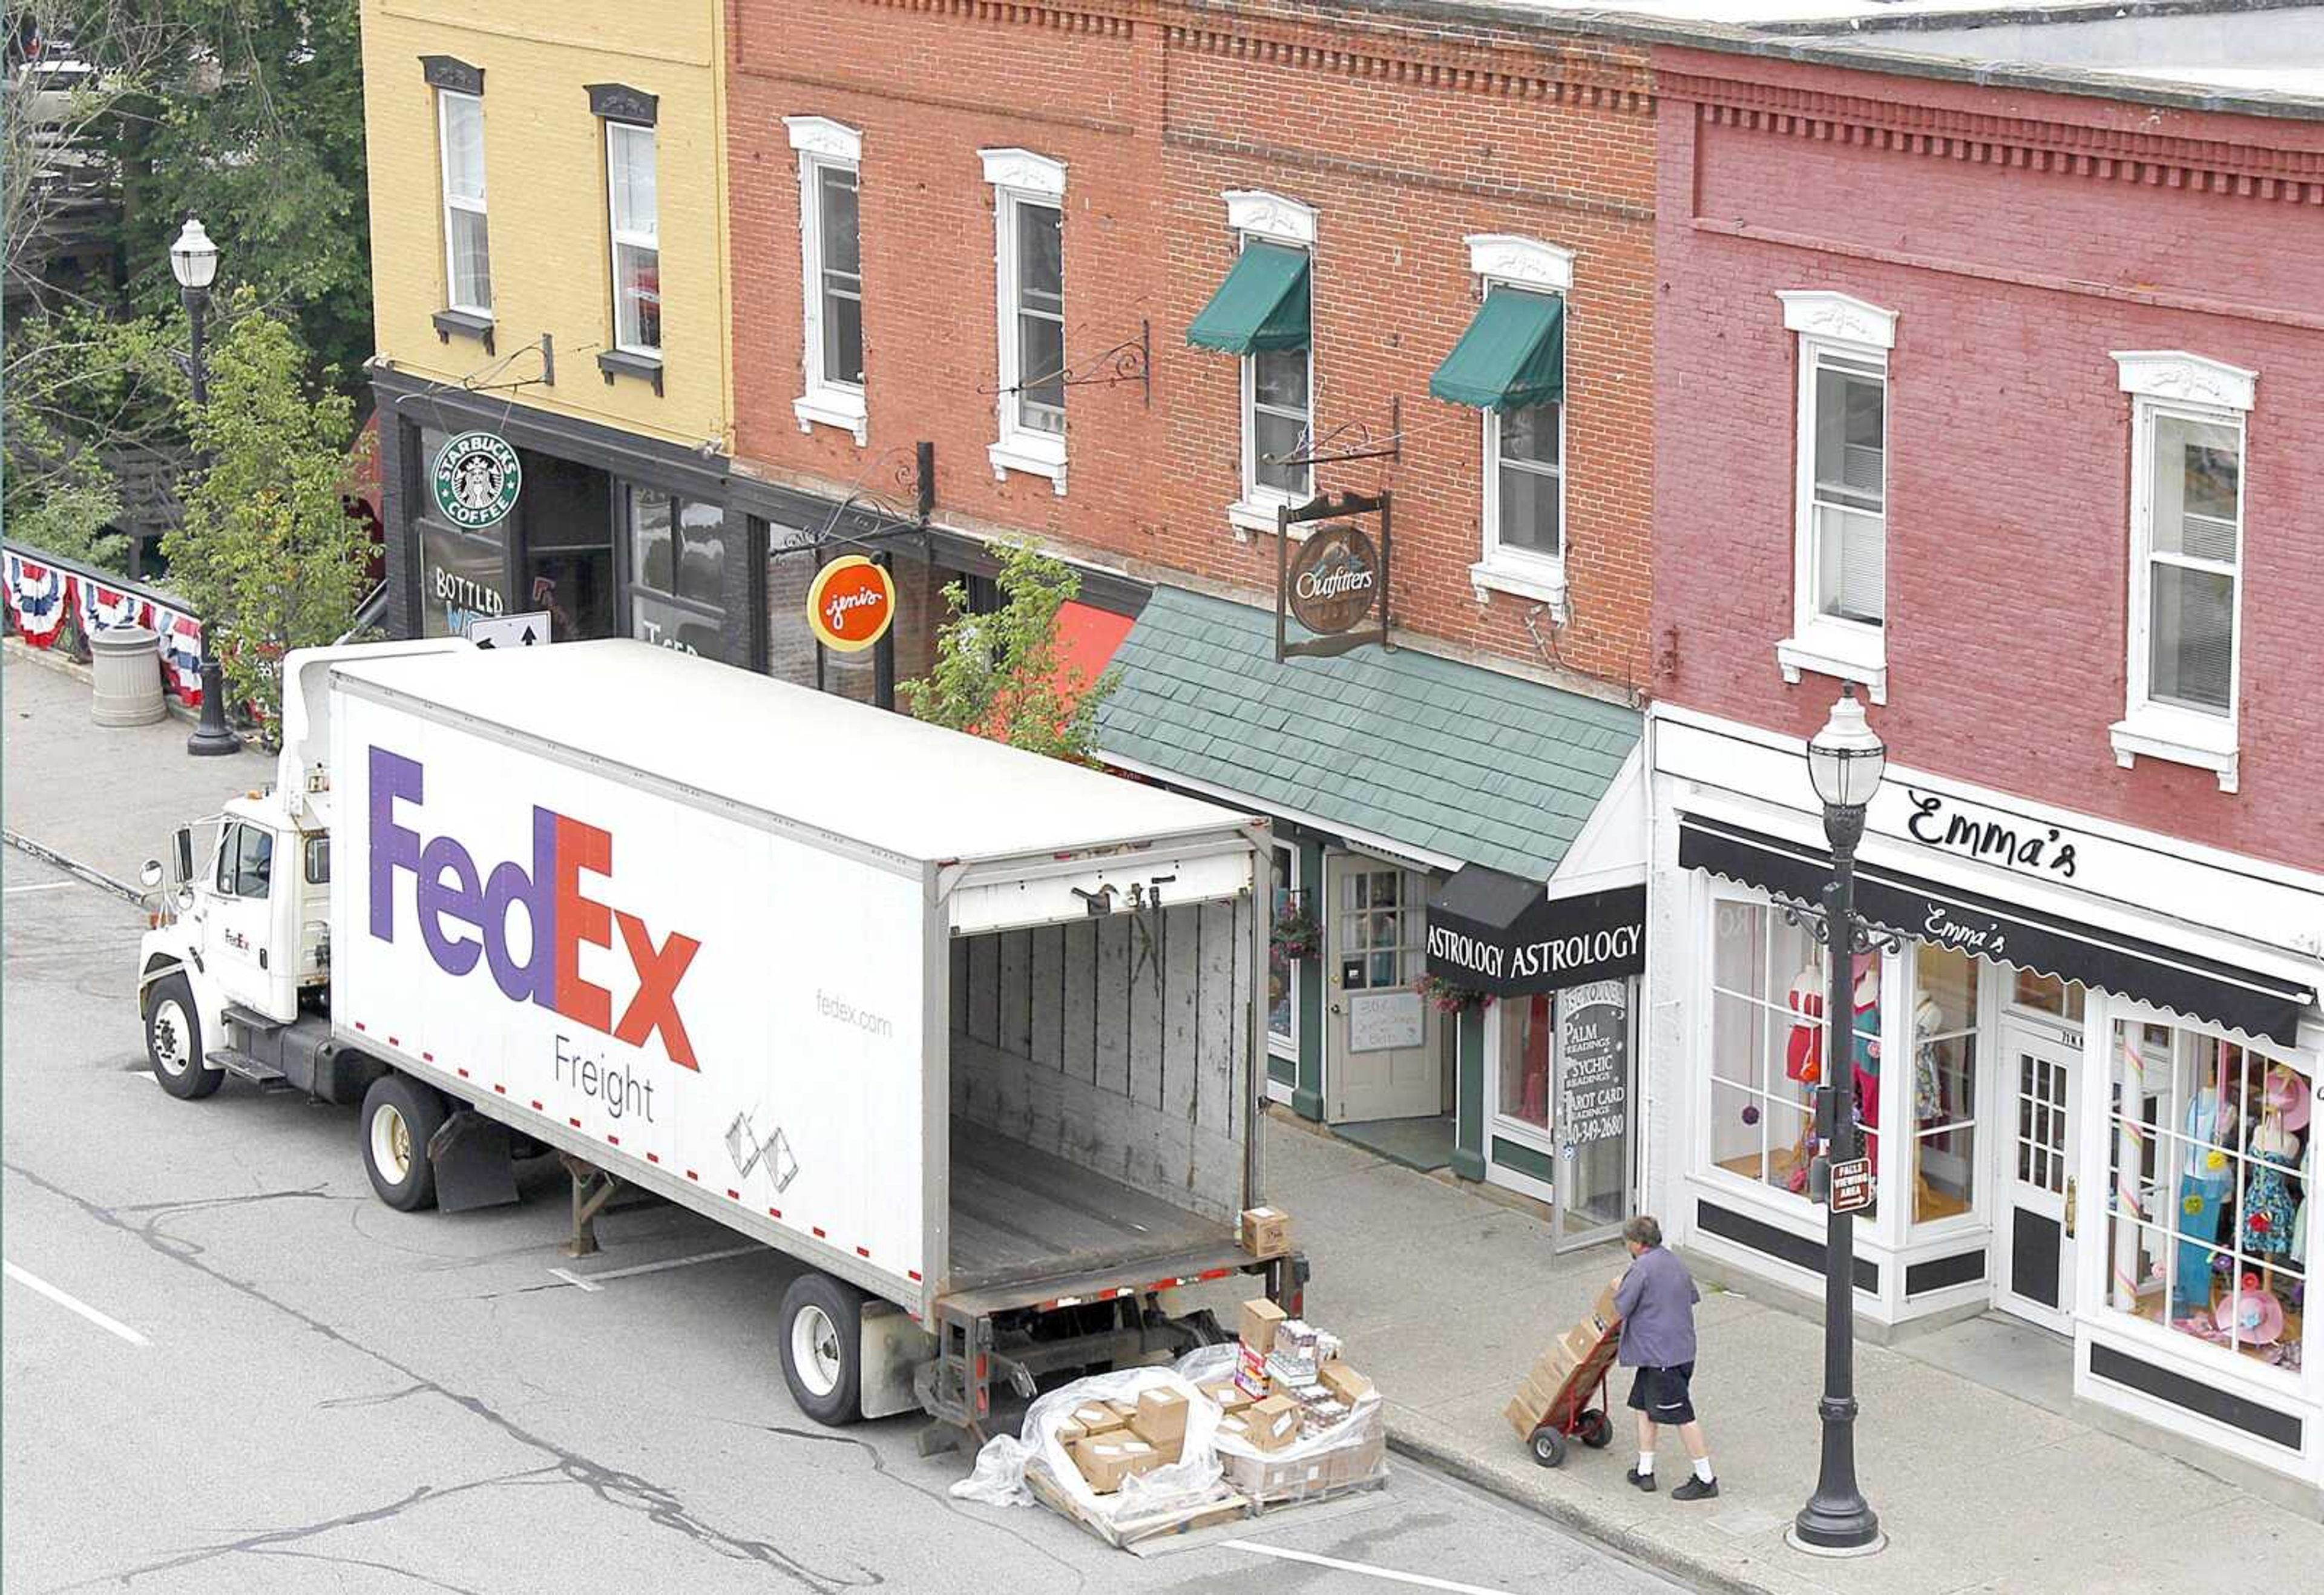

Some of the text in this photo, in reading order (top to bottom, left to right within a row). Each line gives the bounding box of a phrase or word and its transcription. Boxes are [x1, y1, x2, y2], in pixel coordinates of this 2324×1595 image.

[439, 437, 516, 481] STARBUCKS
[448, 496, 509, 522] COFFEE
[436, 566, 503, 613] BOTTLED
[1296, 565, 1373, 599] Outfitters
[1908, 789, 2075, 878] Emma's
[369, 744, 702, 1073] FedEx
[1925, 903, 2005, 953] Emma's
[225, 928, 251, 952] FedEx
[1426, 924, 1504, 978] ASTROLOGY
[1510, 923, 1641, 979] ASTROLOGY
[816, 988, 893, 1039] fedex.com
[1565, 1022, 1597, 1045] PALM
[555, 1034, 654, 1123] Freight
[1598, 1086, 1625, 1106] CARD
